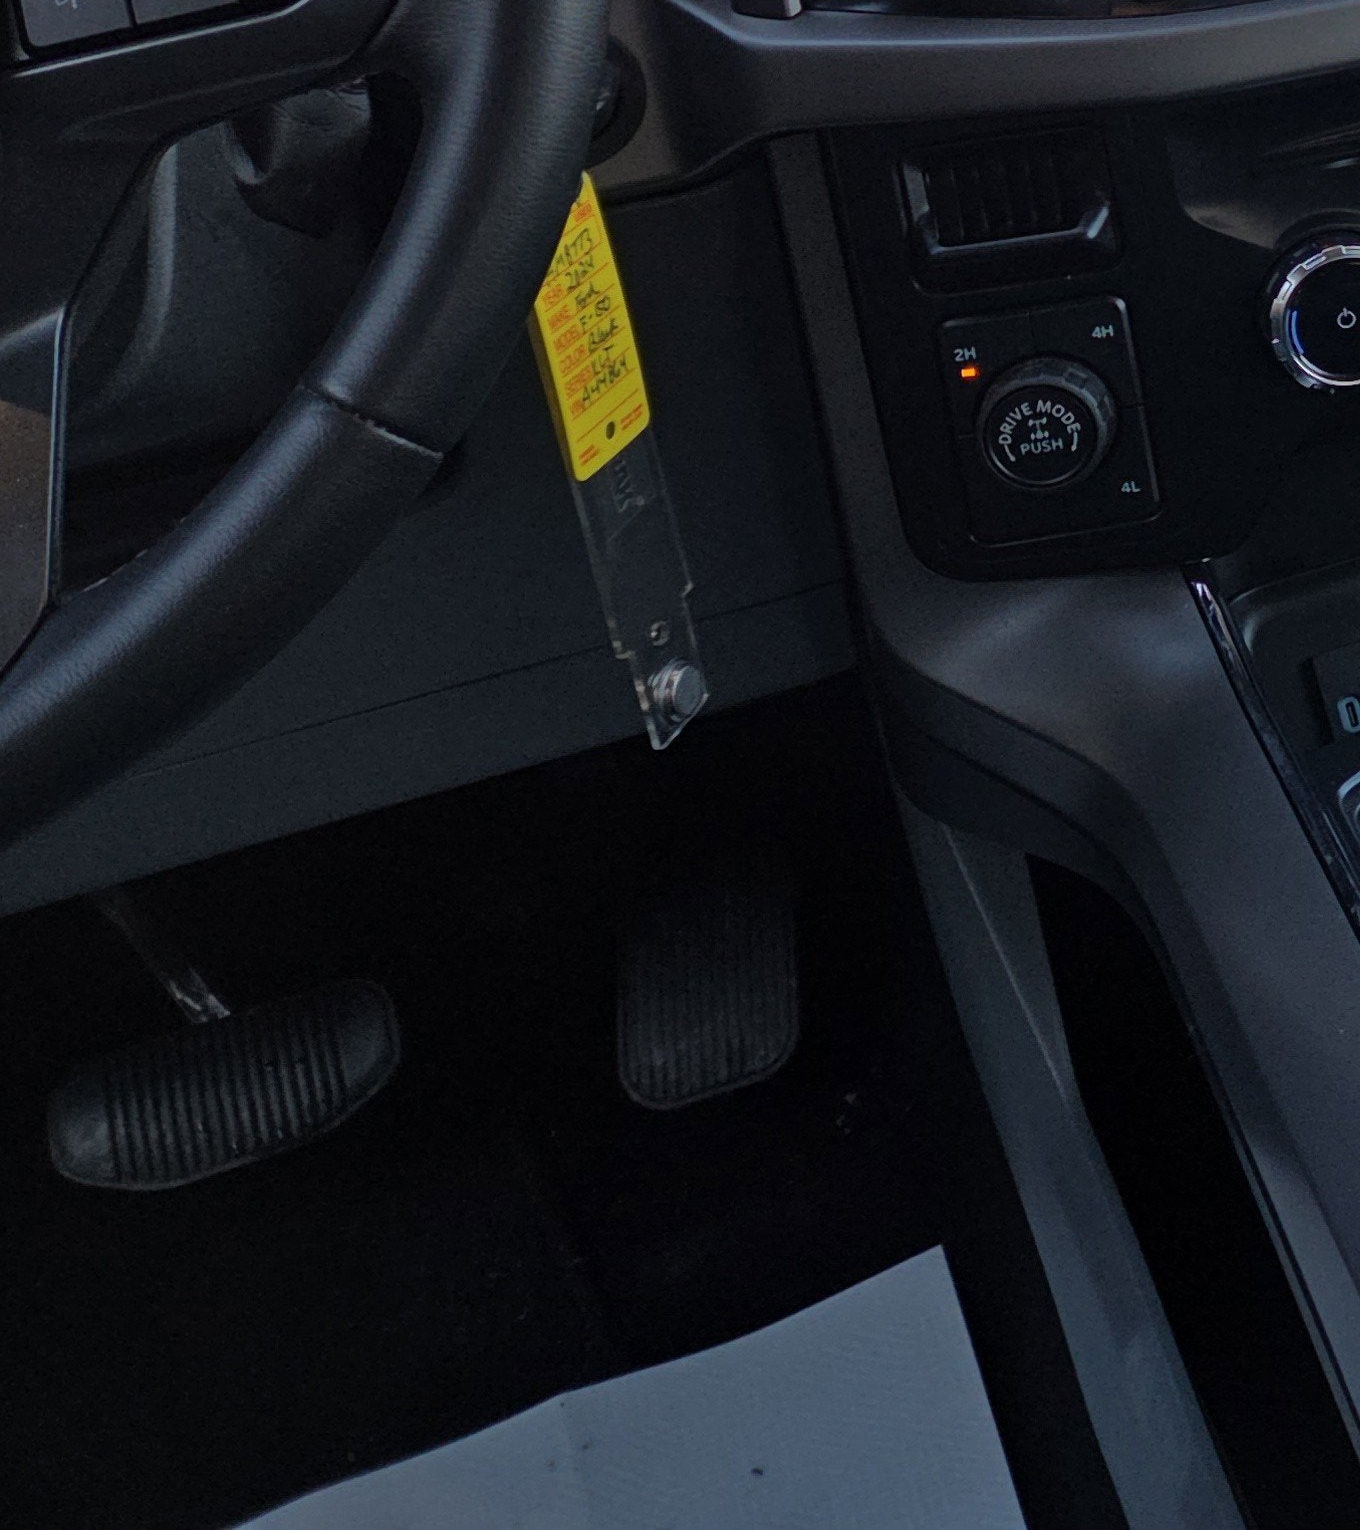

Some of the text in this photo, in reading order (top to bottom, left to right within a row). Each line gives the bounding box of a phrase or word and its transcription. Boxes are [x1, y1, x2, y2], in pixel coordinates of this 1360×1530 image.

[1092, 324, 1115, 339] 4H
[953, 347, 977, 363] 2H
[998, 399, 1082, 446] DRIVE MODE
[1019, 437, 1064, 456] PUSH
[1121, 481, 1142, 493] 4L
